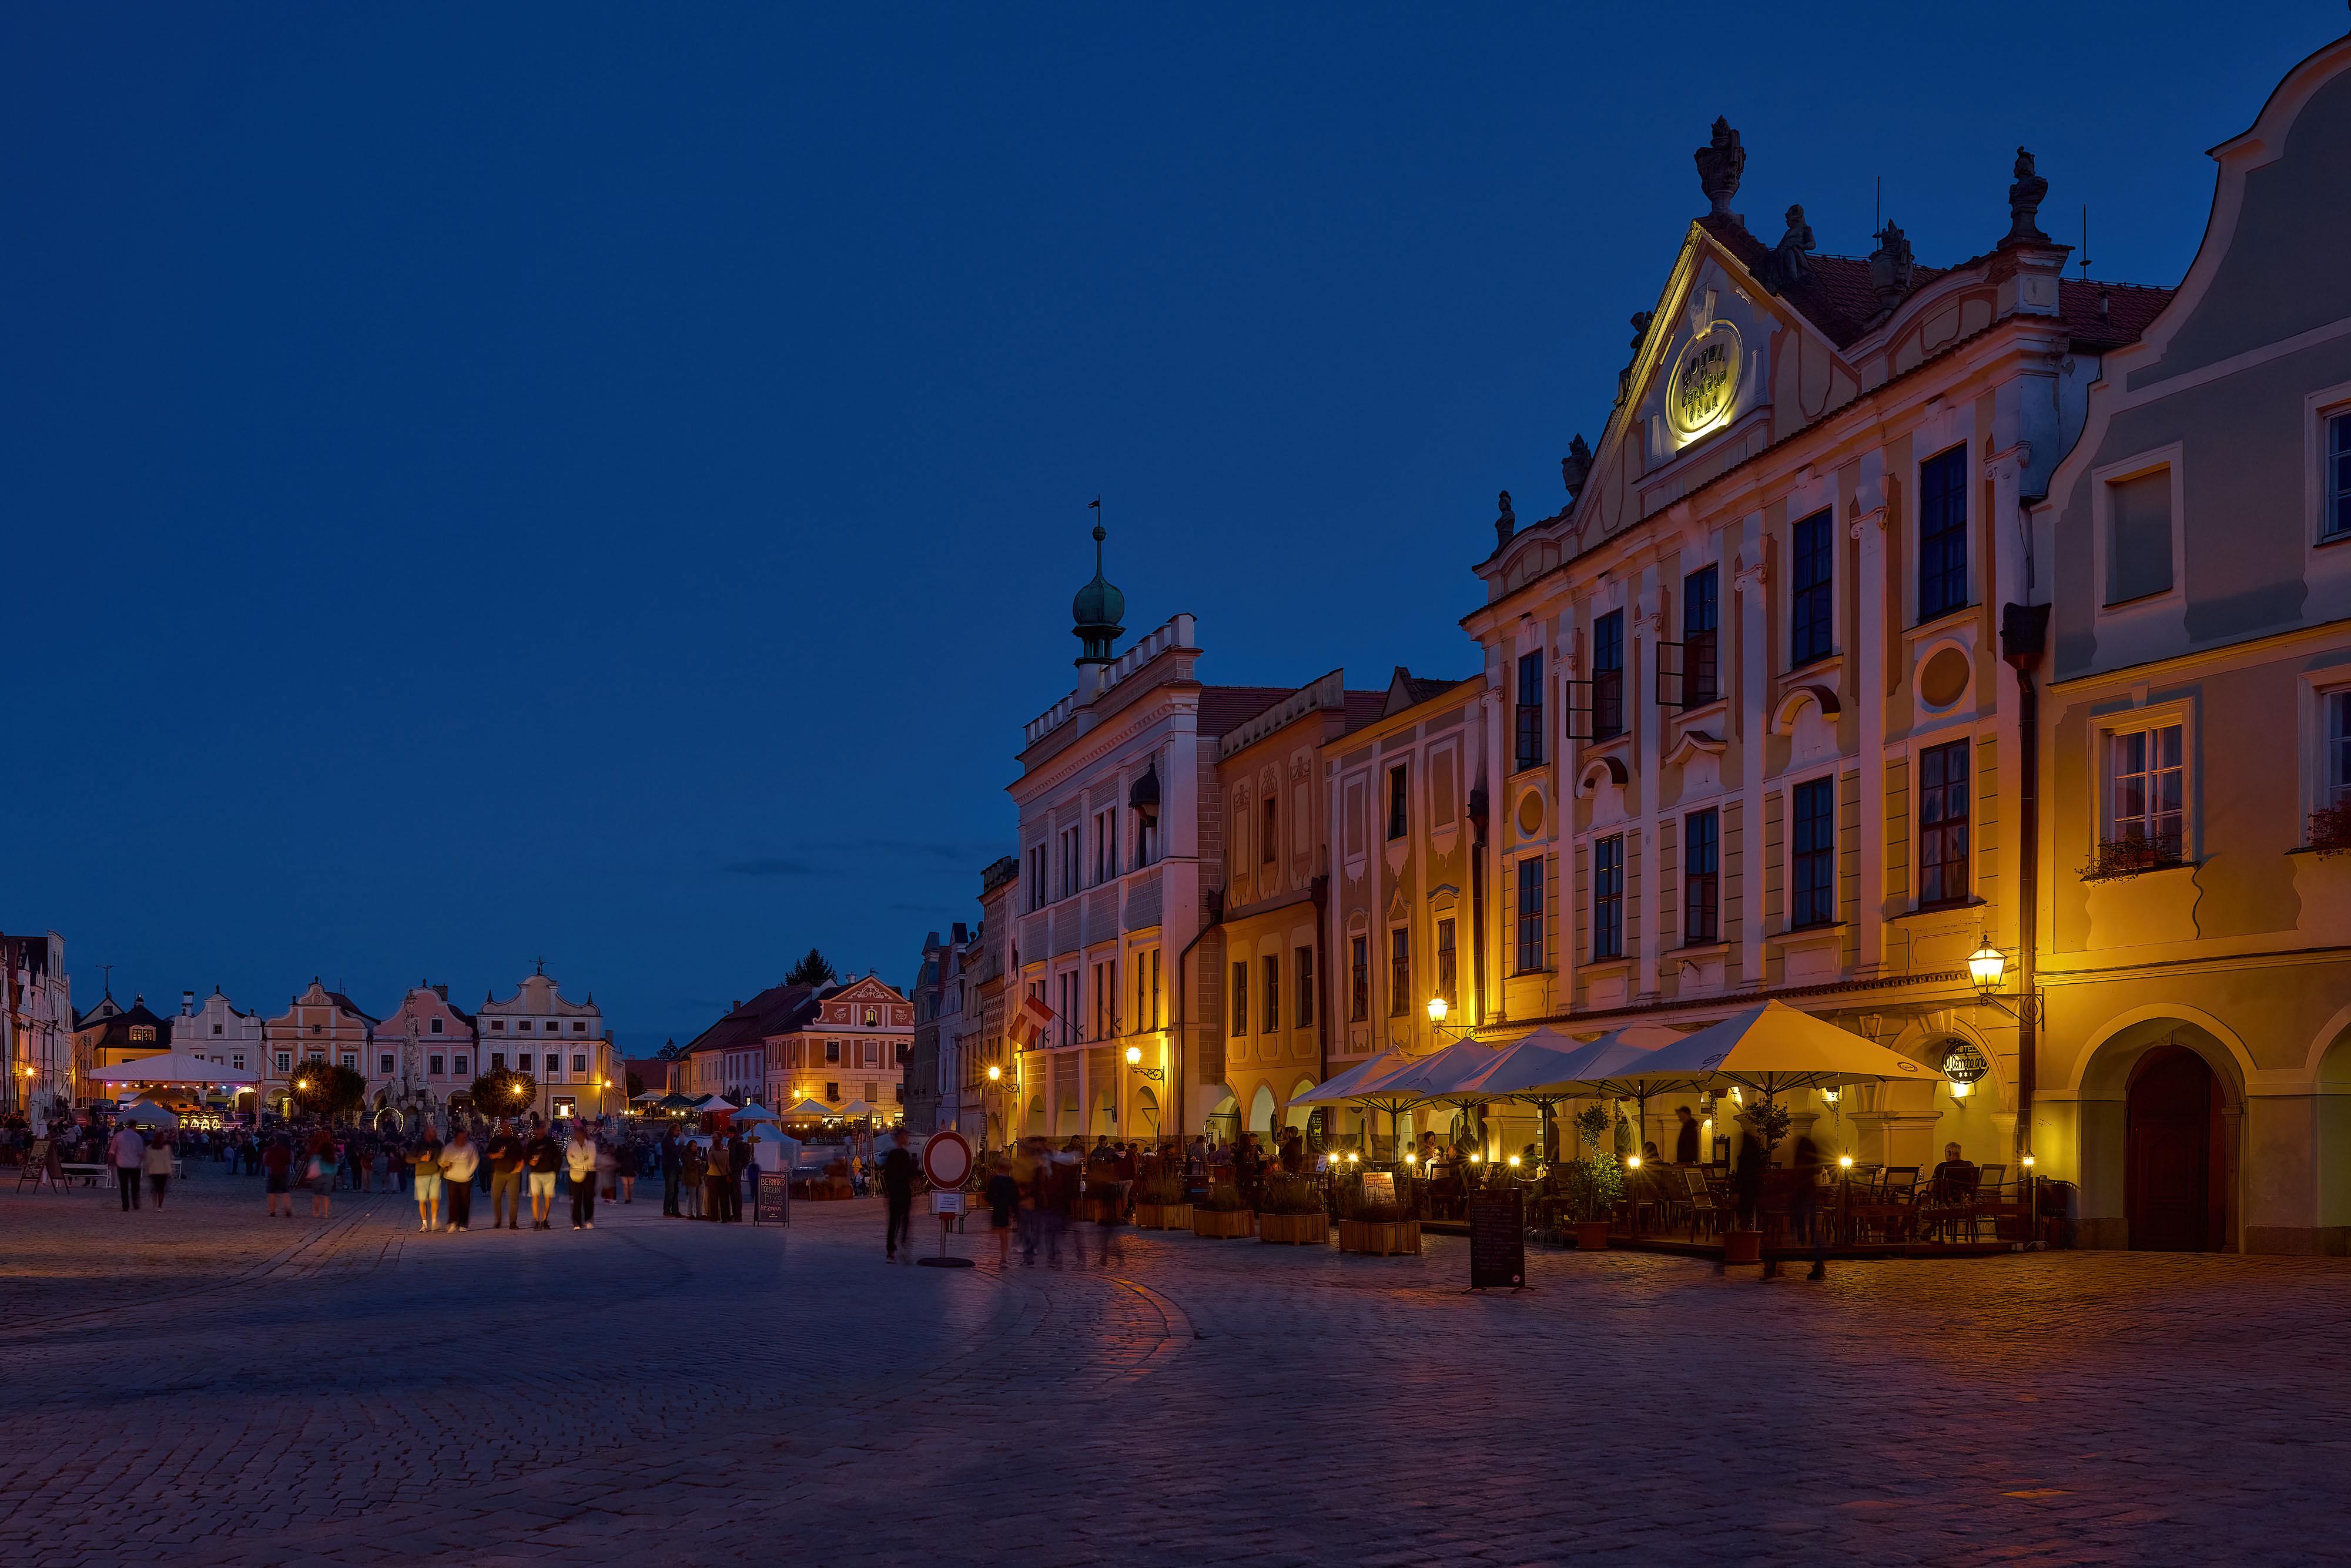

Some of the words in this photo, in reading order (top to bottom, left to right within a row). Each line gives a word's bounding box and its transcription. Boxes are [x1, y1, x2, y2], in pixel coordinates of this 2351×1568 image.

[1682, 344, 1724, 388] HOTEL
[1700, 368, 1707, 380] U
[1689, 395, 1719, 423] ORLA
